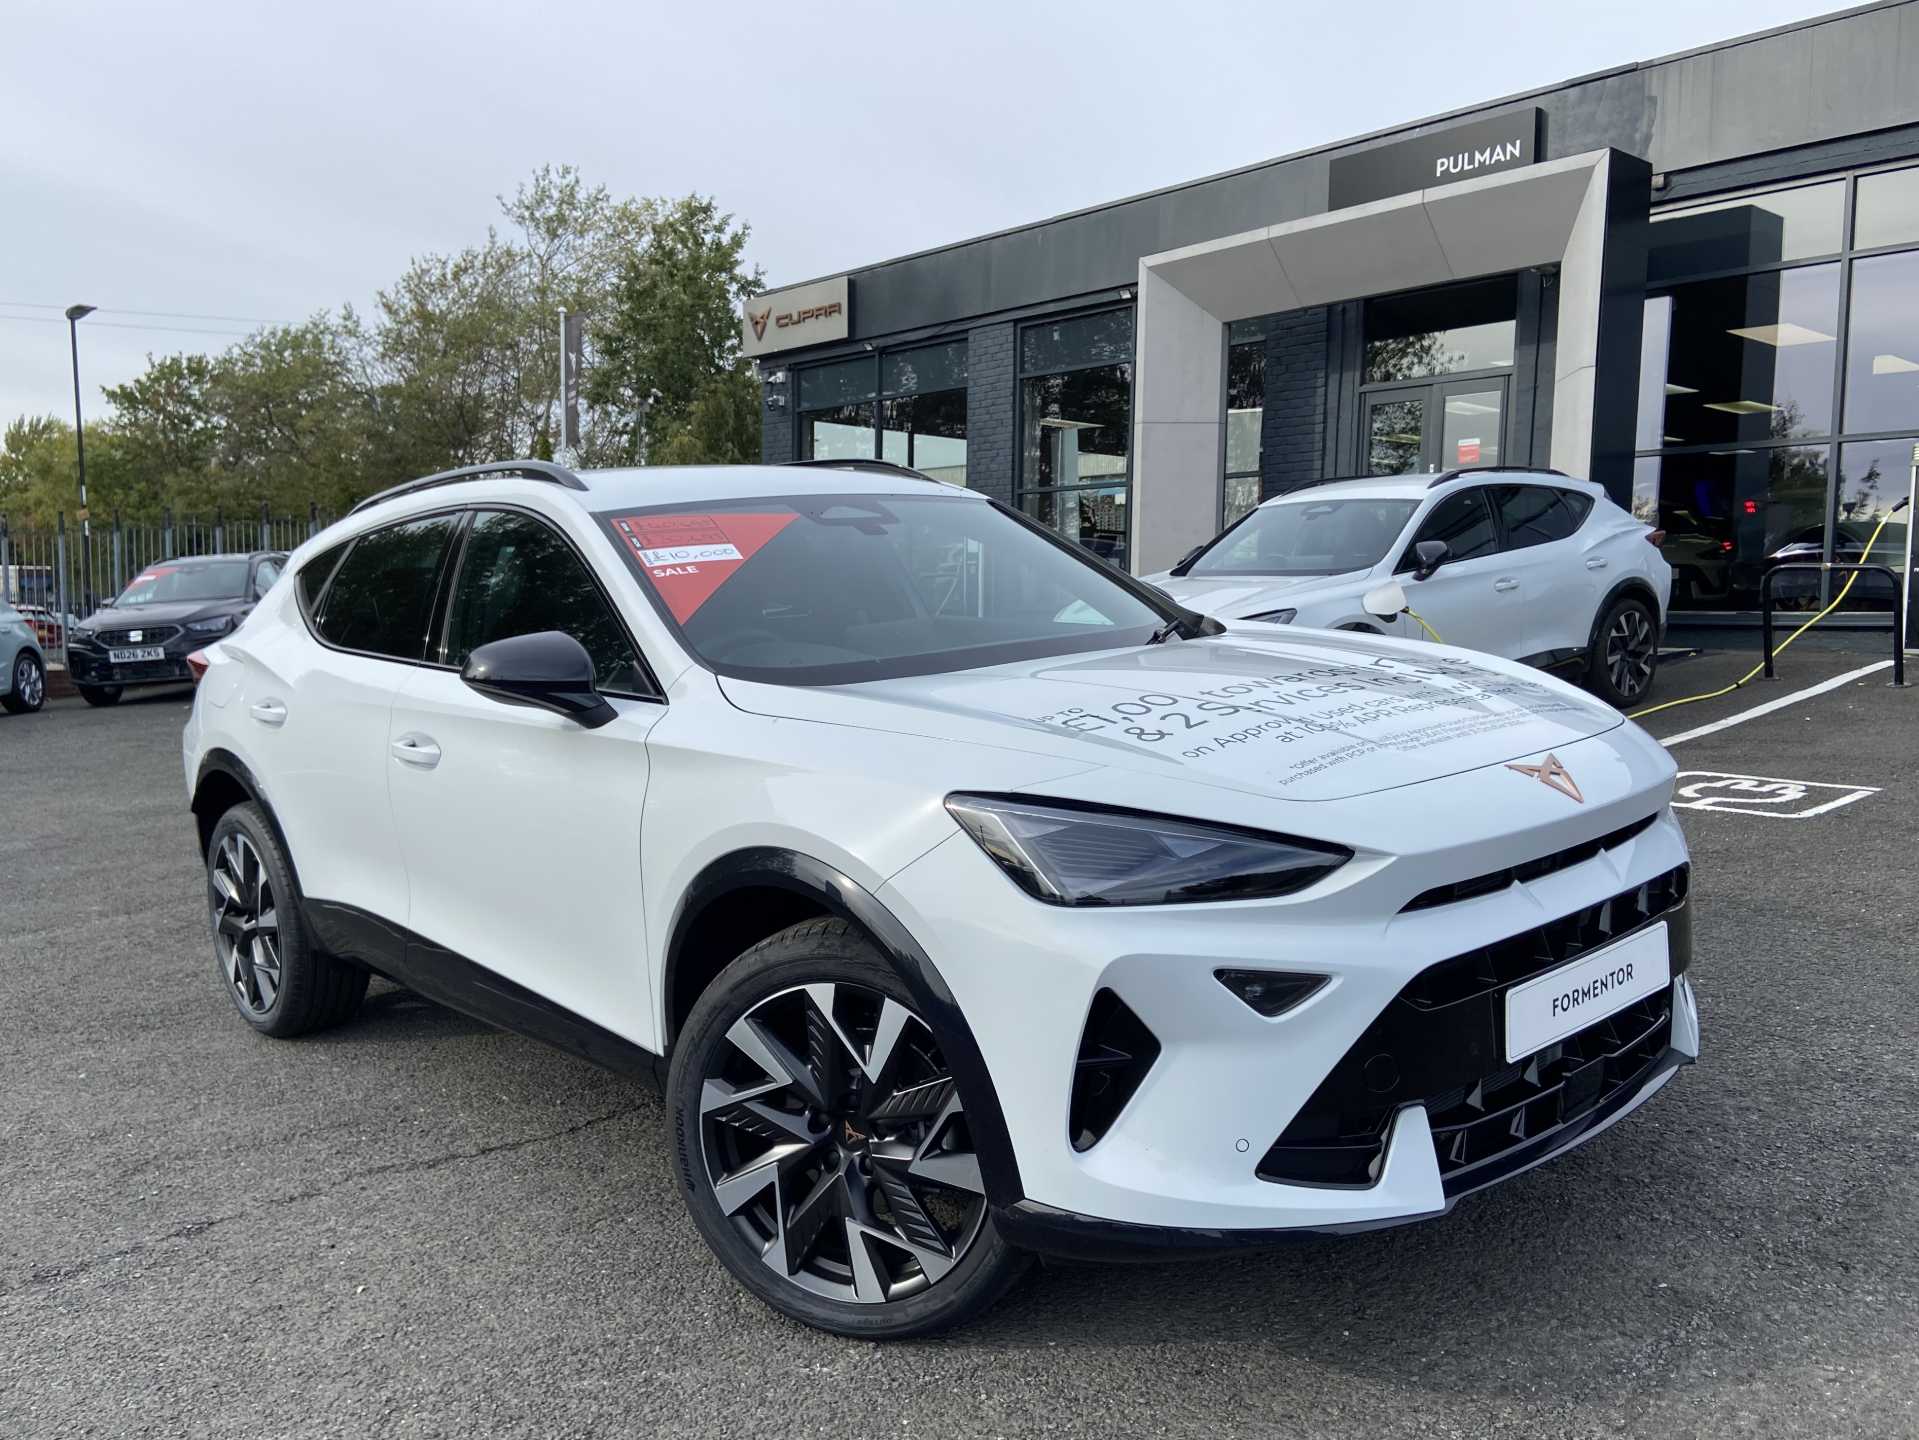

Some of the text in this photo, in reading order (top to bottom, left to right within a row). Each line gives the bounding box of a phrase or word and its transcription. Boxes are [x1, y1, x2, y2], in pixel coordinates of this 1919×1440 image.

[1436, 139, 1520, 177] PULMAN
[776, 302, 841, 328] CUPRA
[653, 565, 699, 578] SALE
[1056, 706, 1084, 717] TO
[1123, 726, 1174, 742] &
[1159, 712, 1208, 729] 2
[1197, 682, 1366, 716] Srvices
[1182, 745, 1215, 758] on
[1213, 714, 1318, 749] Approvd
[1310, 702, 1366, 720] Used
[1275, 730, 1304, 742] at
[1553, 963, 1634, 1017] FORMENTOR
